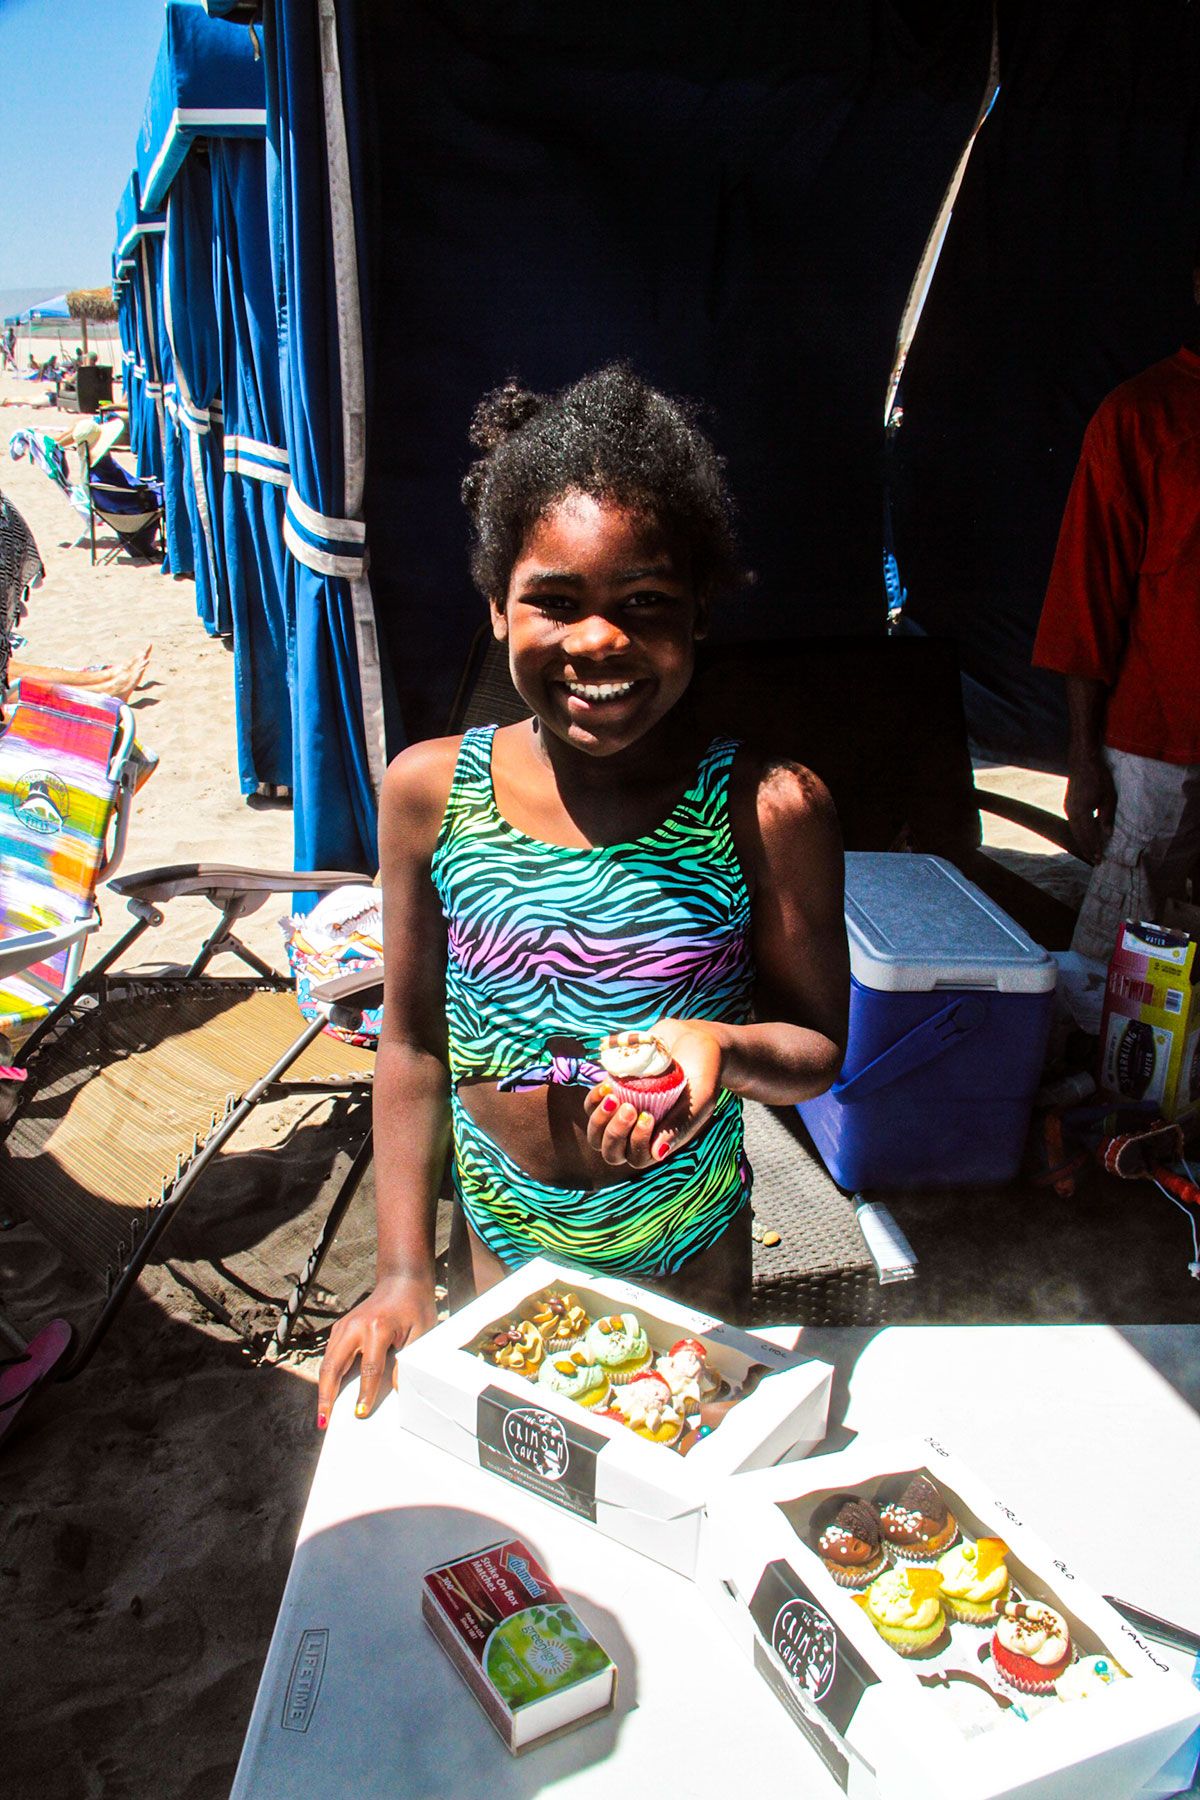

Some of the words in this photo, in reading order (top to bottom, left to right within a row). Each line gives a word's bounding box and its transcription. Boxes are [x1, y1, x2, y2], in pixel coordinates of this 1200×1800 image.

[1145, 934, 1166, 946] WATER
[1119, 1030, 1137, 1088] SPARKLING
[1144, 1049, 1153, 1077] WATER
[508, 1420, 564, 1460] CRIMSON
[514, 1443, 538, 1464] CAKE
[443, 1576, 455, 1590] 300
[471, 1560, 497, 1592] Matches
[481, 1557, 500, 1579] Strike
[496, 1578, 508, 1591] On
[504, 1590, 519, 1606] Box
[510, 1559, 544, 1597] diamond
[460, 1617, 470, 1630] Since
[476, 1628, 486, 1639] USA
[801, 1611, 812, 1626] THE
[778, 1639, 801, 1673] CAKE
[782, 1611, 832, 1683] CRIMSON
[1121, 1625, 1170, 1672] VANILLA
[290, 1643, 322, 1719] LIFETIME
